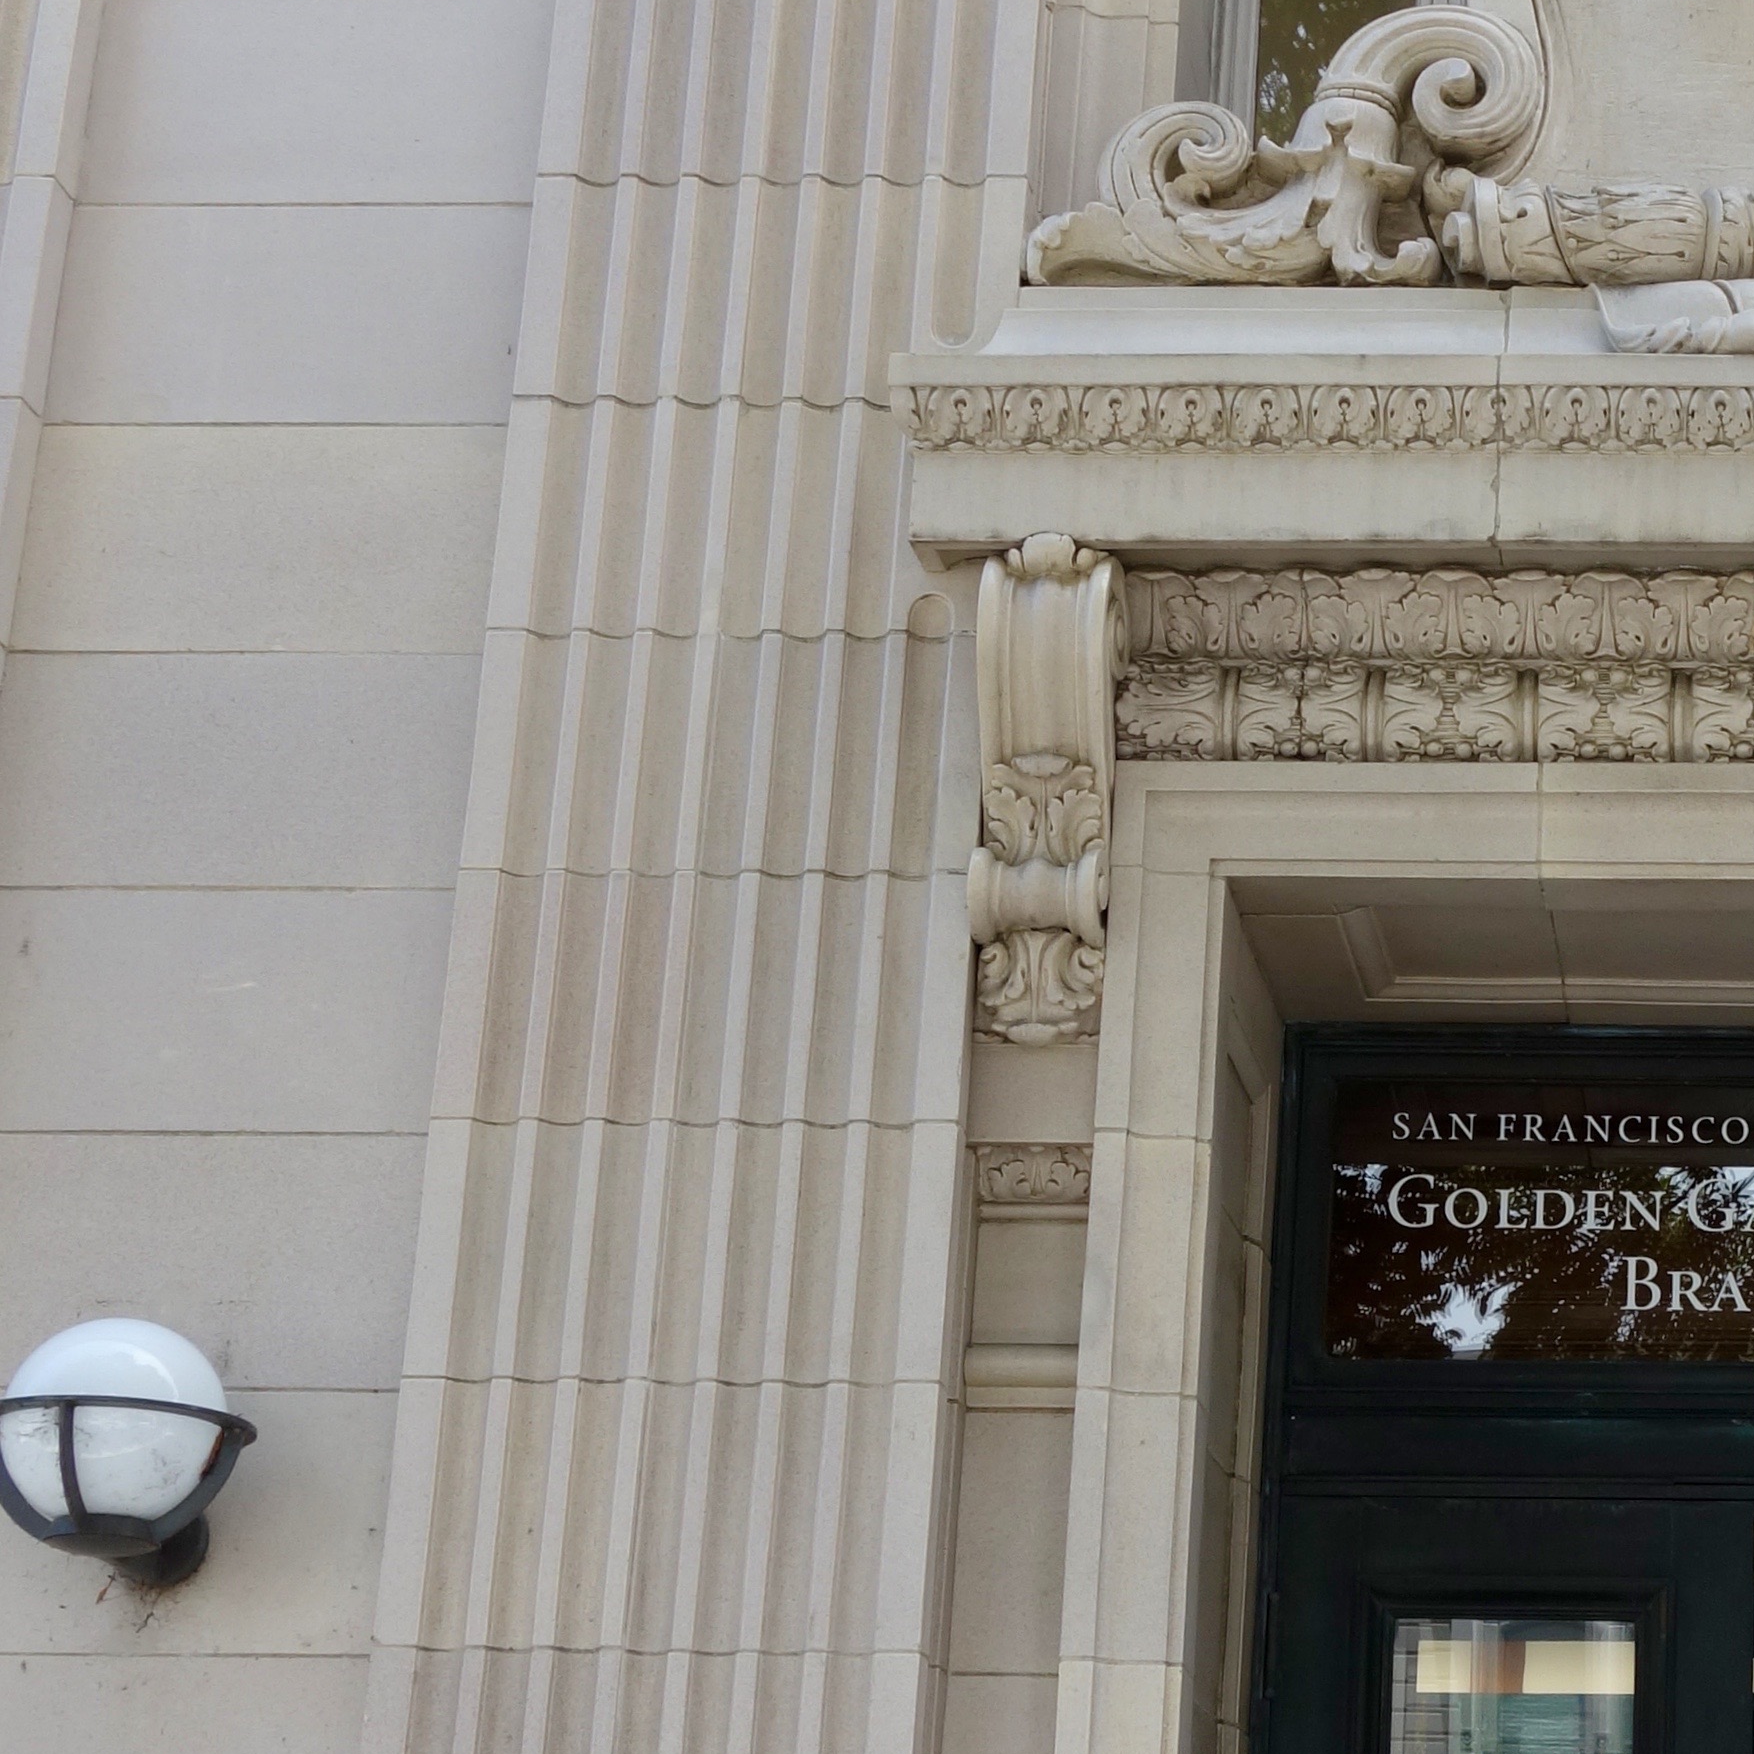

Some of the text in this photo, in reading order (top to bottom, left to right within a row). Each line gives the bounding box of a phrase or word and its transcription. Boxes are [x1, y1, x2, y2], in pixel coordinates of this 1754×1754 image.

[1392, 1112, 1477, 1141] SAN
[1496, 1114, 1750, 1145] FRANCISCO
[1387, 1173, 1666, 1232] GOLDEN
